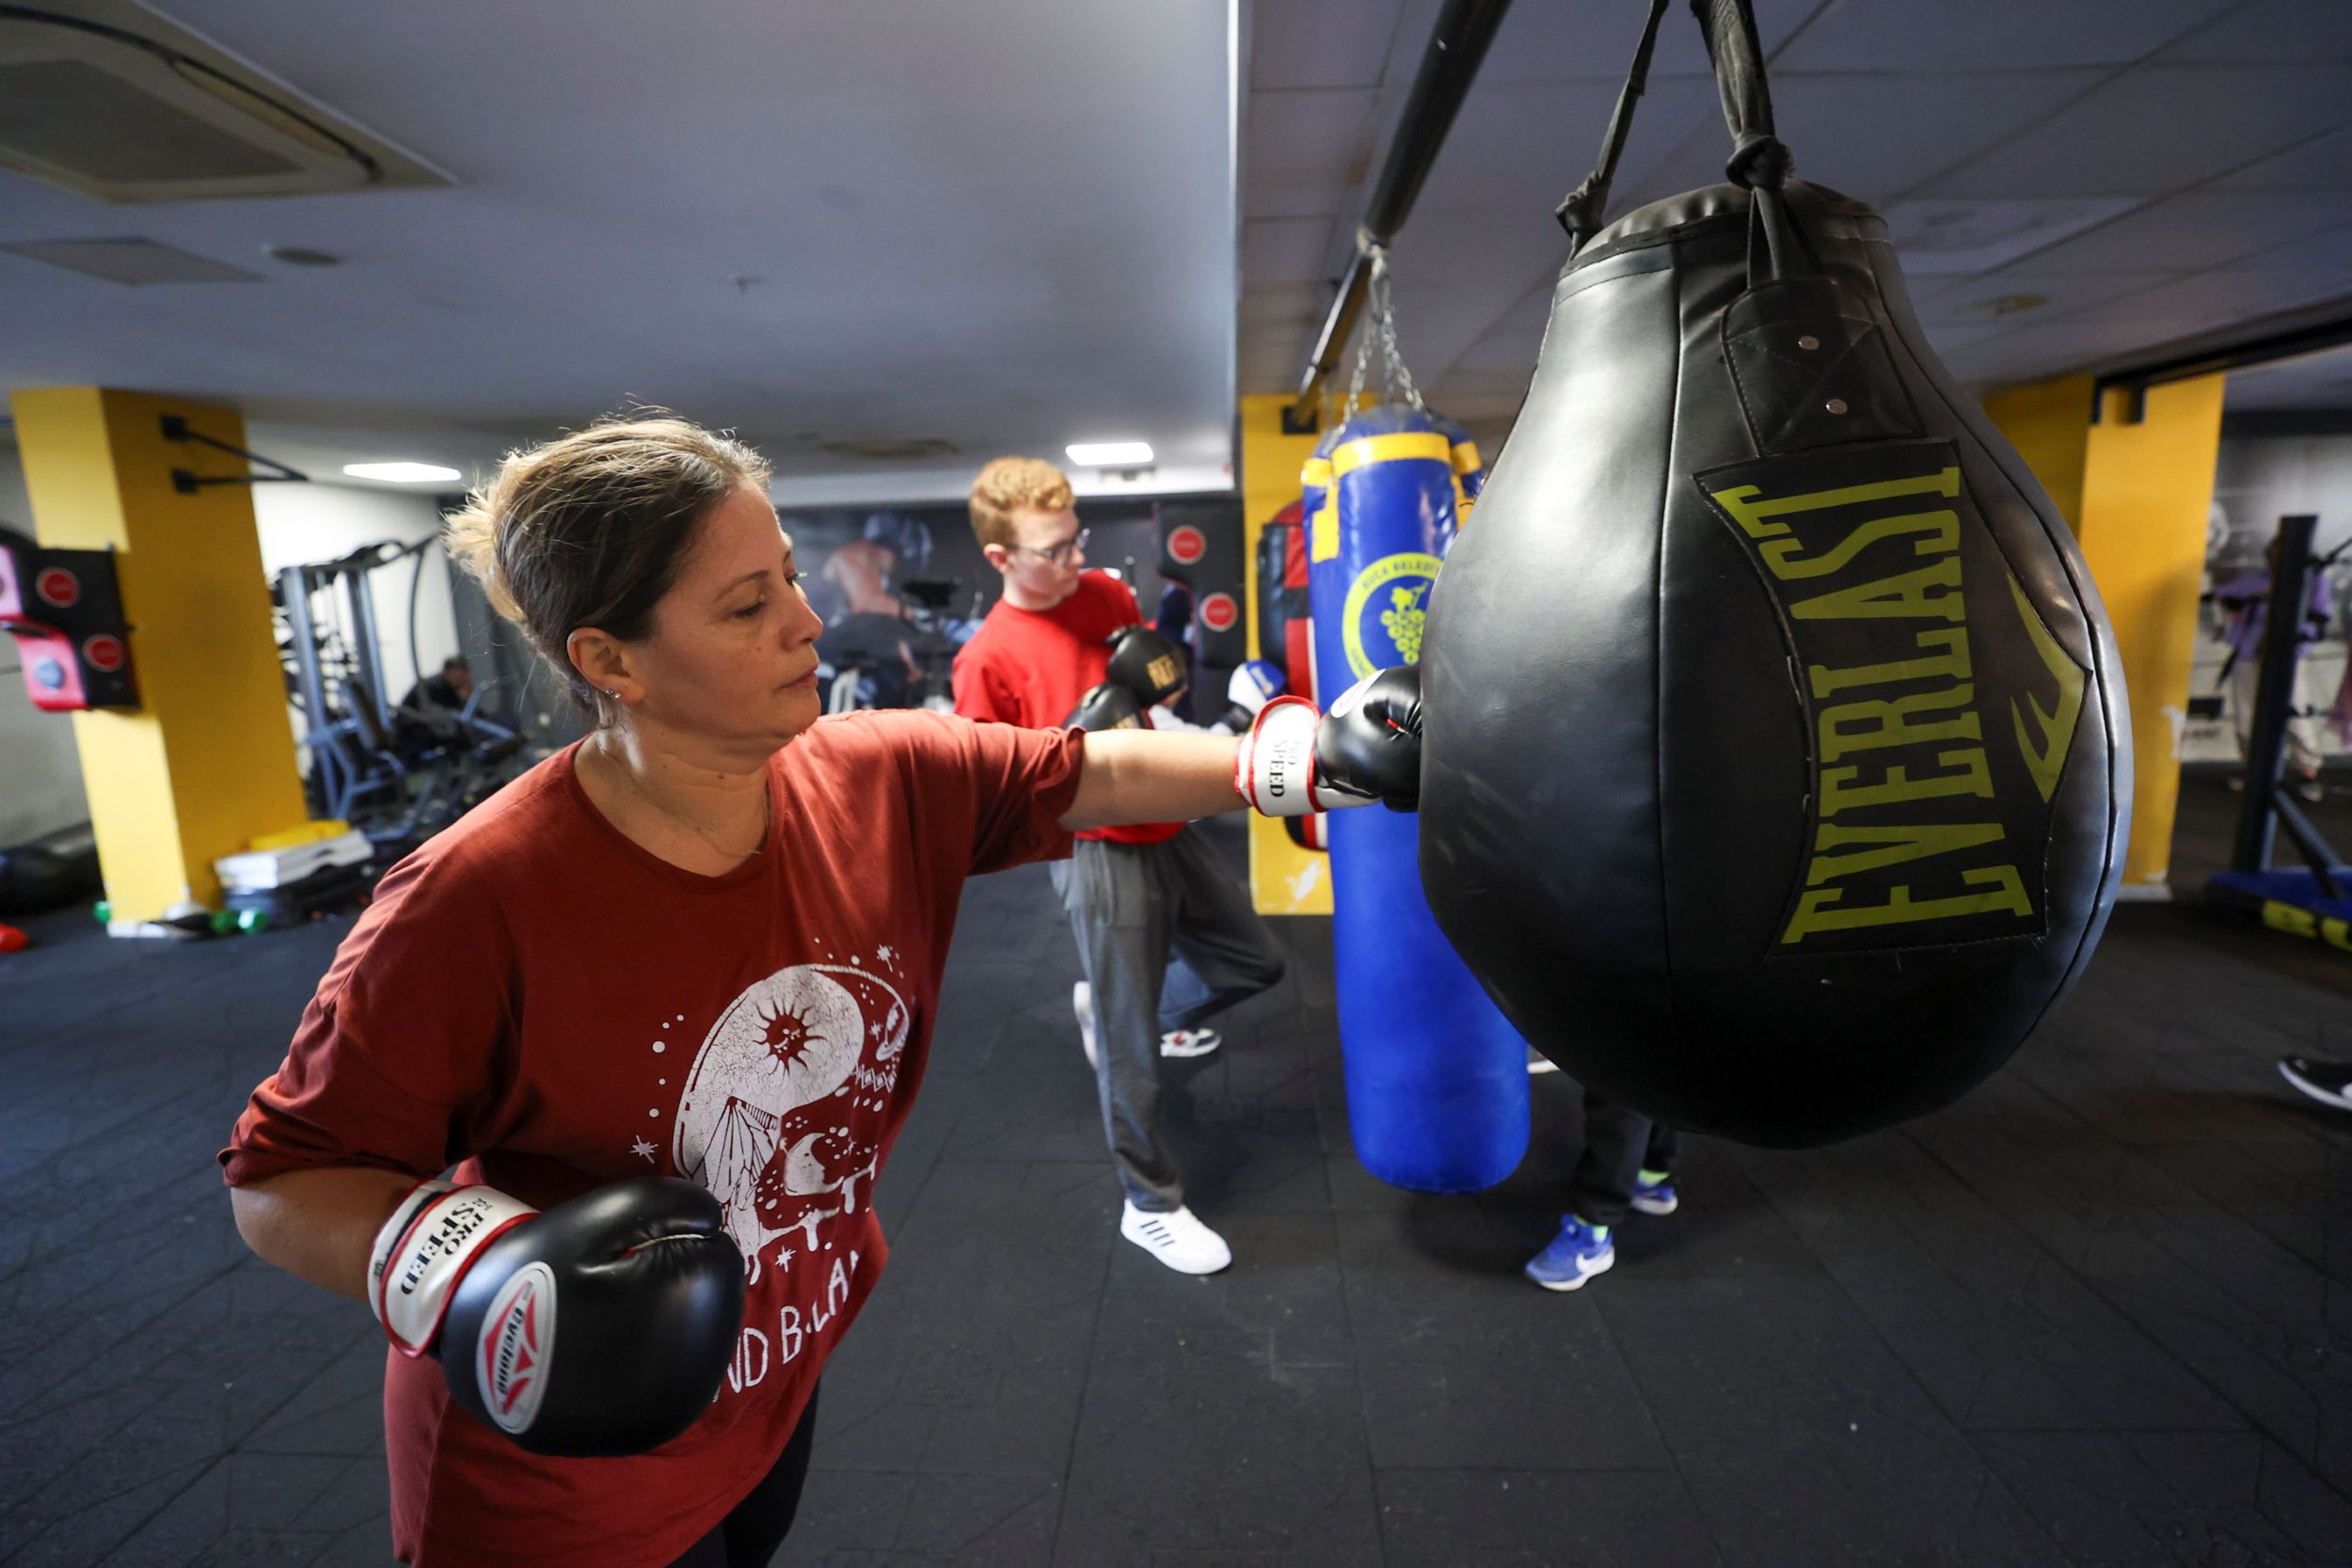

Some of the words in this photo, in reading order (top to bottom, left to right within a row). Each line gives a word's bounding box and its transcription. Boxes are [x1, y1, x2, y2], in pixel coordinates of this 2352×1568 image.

[1711, 467, 2033, 943] EVERLAST
[1269, 739, 1289, 798] SPEED
[401, 1203, 475, 1295] SPEED
[445, 1212, 485, 1256] PRO
[712, 1327, 769, 1402] ND
